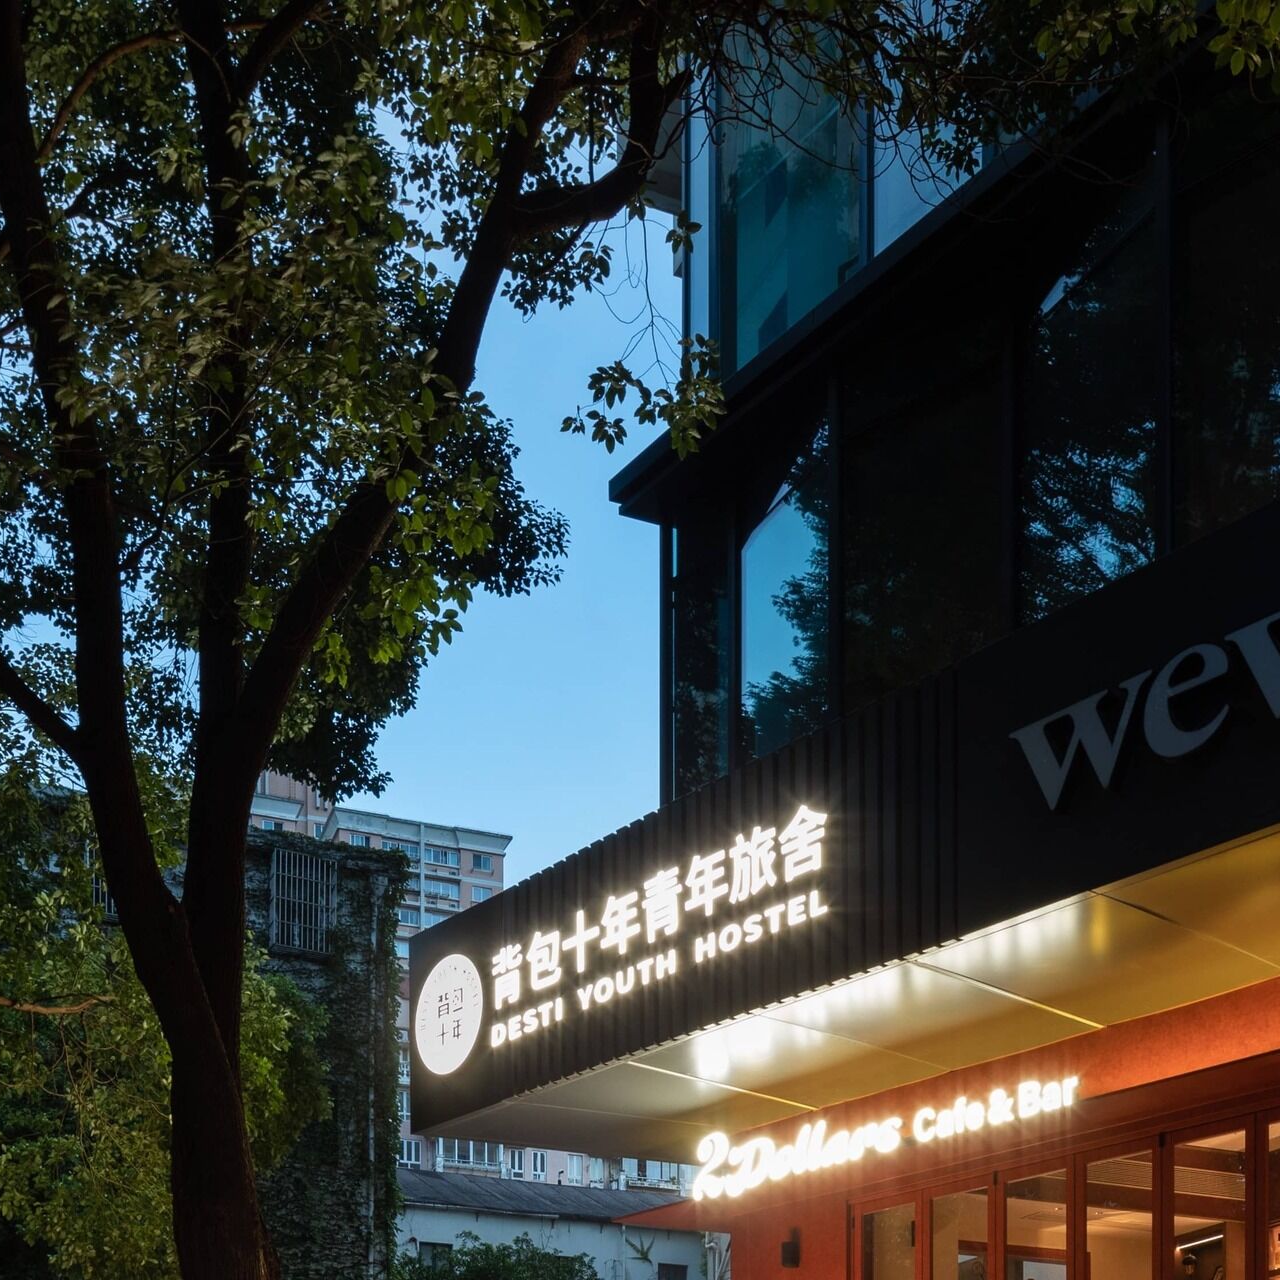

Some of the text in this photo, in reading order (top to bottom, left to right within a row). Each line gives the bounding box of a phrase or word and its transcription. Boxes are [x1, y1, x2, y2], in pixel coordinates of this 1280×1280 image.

[491, 804, 828, 1010] 背包十年青年旅舍
[491, 996, 563, 1048] DESTI
[577, 948, 677, 1011] YOUTH
[694, 889, 829, 961] HOSTEL
